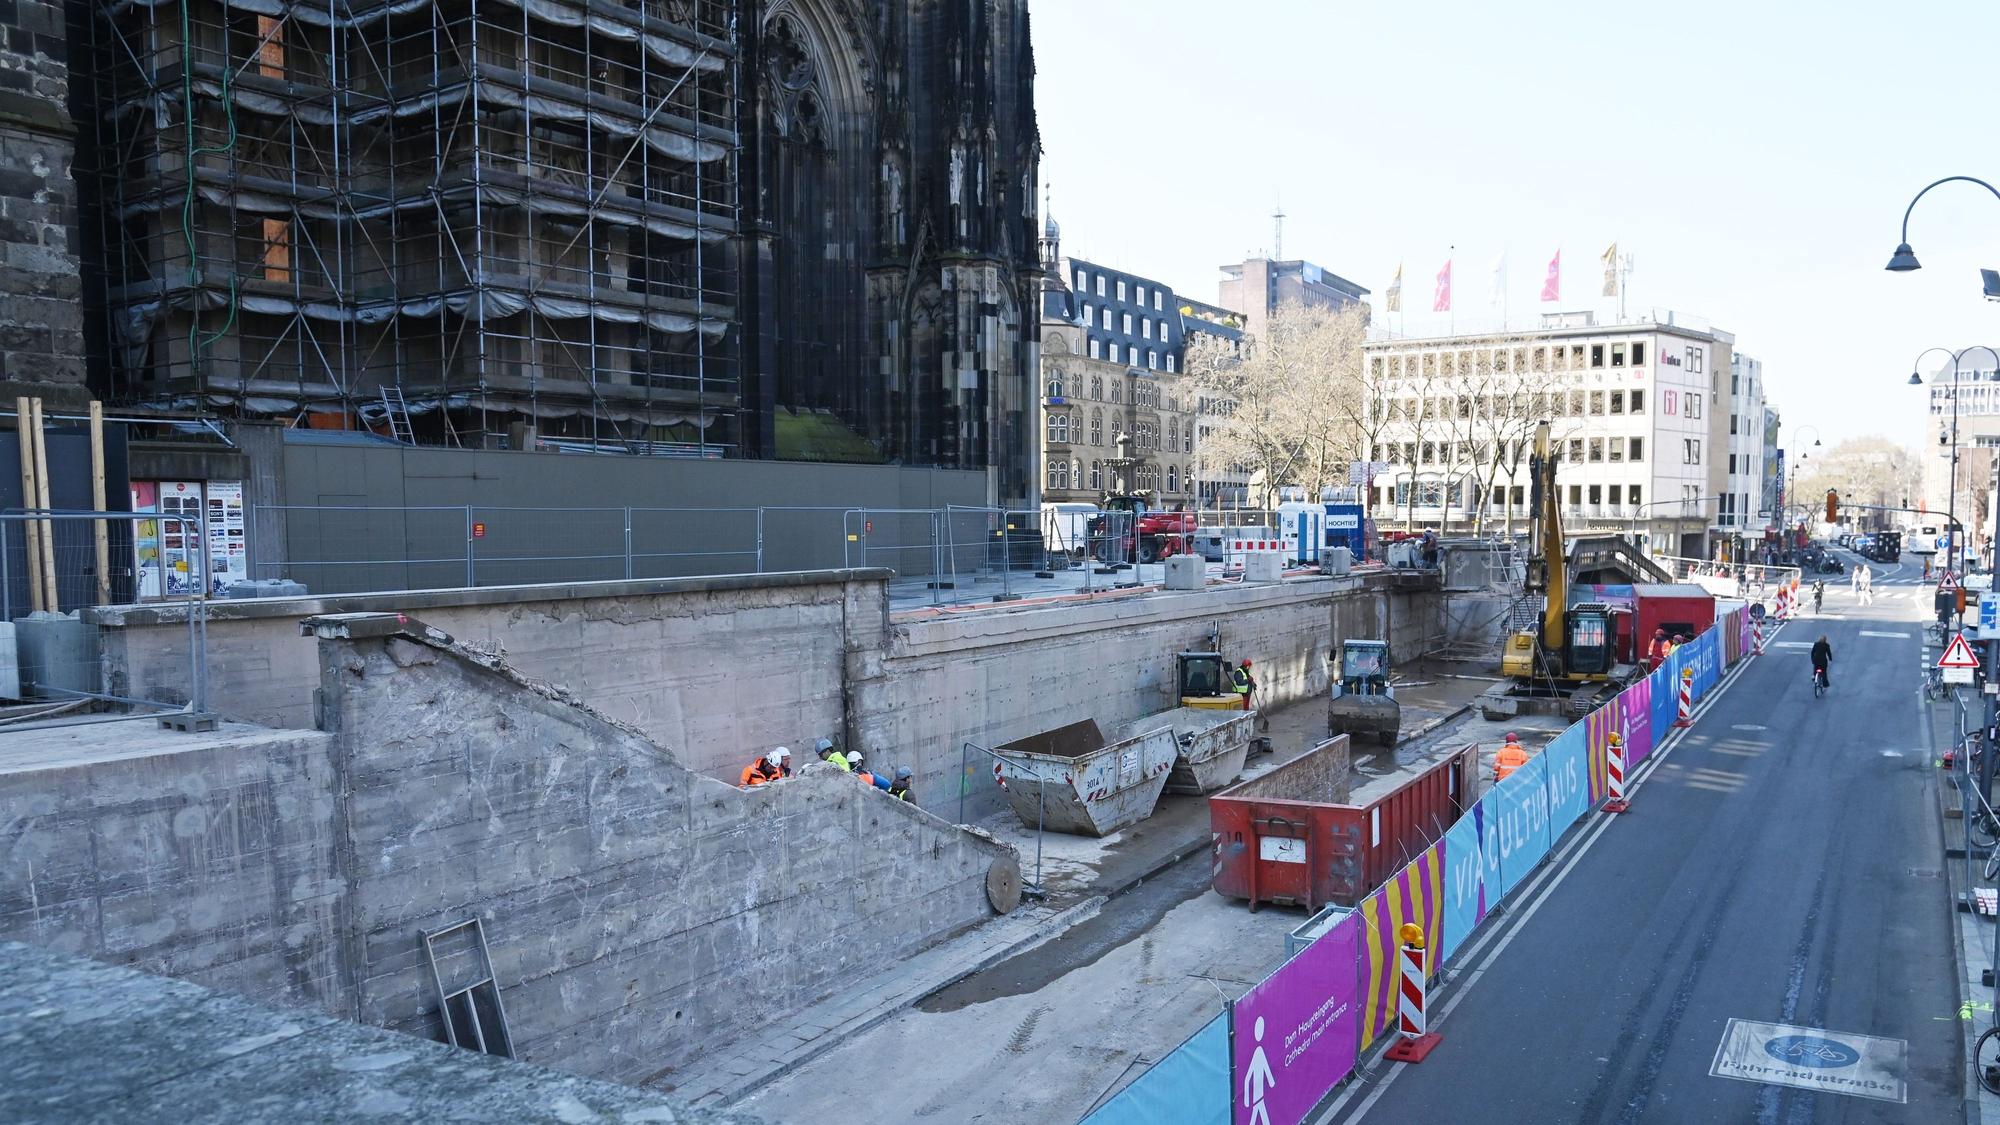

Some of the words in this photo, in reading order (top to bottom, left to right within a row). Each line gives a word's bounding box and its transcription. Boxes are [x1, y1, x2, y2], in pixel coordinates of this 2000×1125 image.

[1086, 776, 1099, 790] 3014
[1455, 842, 1484, 909] VIA
[1488, 756, 1577, 872] CULTURALIS
[1284, 1030, 1297, 1049] Dom
[1298, 995, 1335, 1036] Haupteingang
[1284, 1033, 1312, 1067] Cathedral
[1311, 1021, 1326, 1041] main
[1325, 1001, 1347, 1028] entrance
